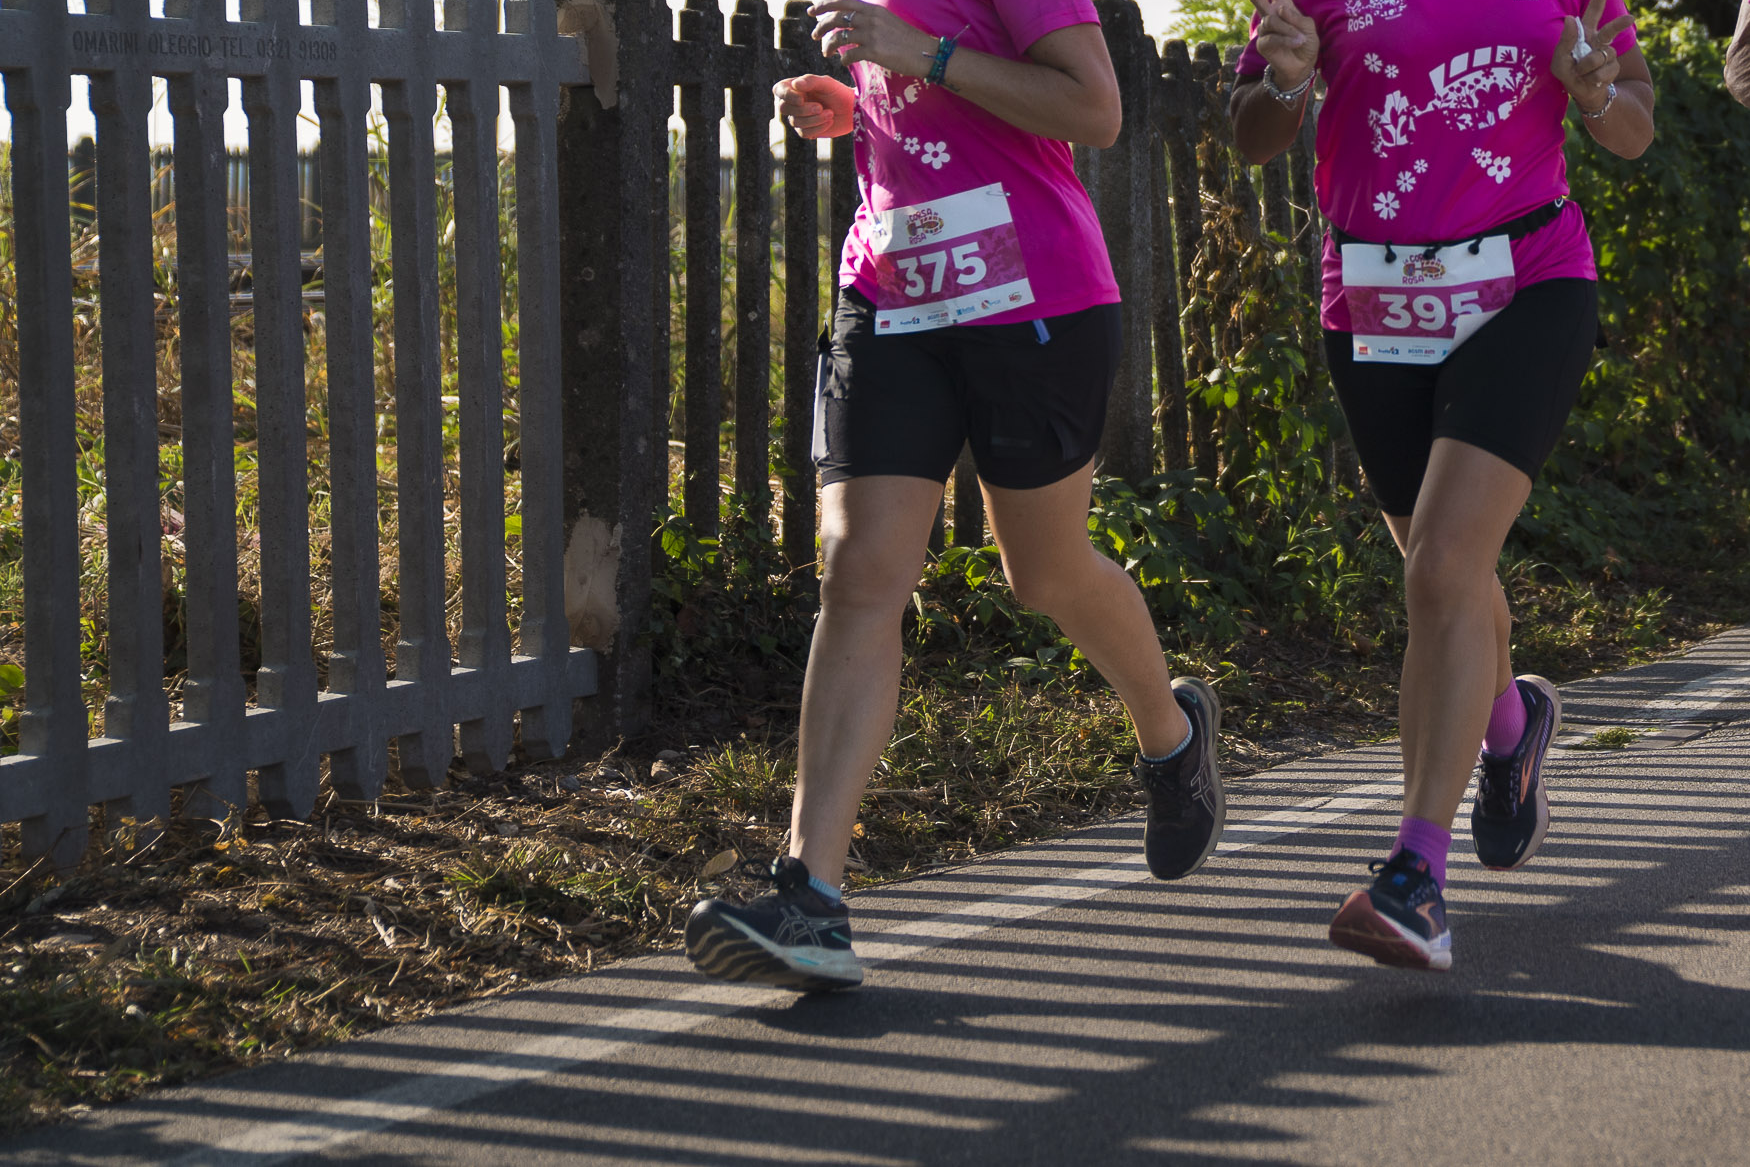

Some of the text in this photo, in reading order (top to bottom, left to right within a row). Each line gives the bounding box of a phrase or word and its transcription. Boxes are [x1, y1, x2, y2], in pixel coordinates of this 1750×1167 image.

[1348, 14, 1374, 32] ROSA
[72, 31, 337, 61] OMARINI OLEGGIO TEL. 0321 91308
[909, 208, 932, 222] CORSA
[909, 232, 927, 244] ROSA
[896, 242, 987, 298] 375
[1402, 275, 1424, 284] ROSA
[1378, 291, 1483, 331] 395
